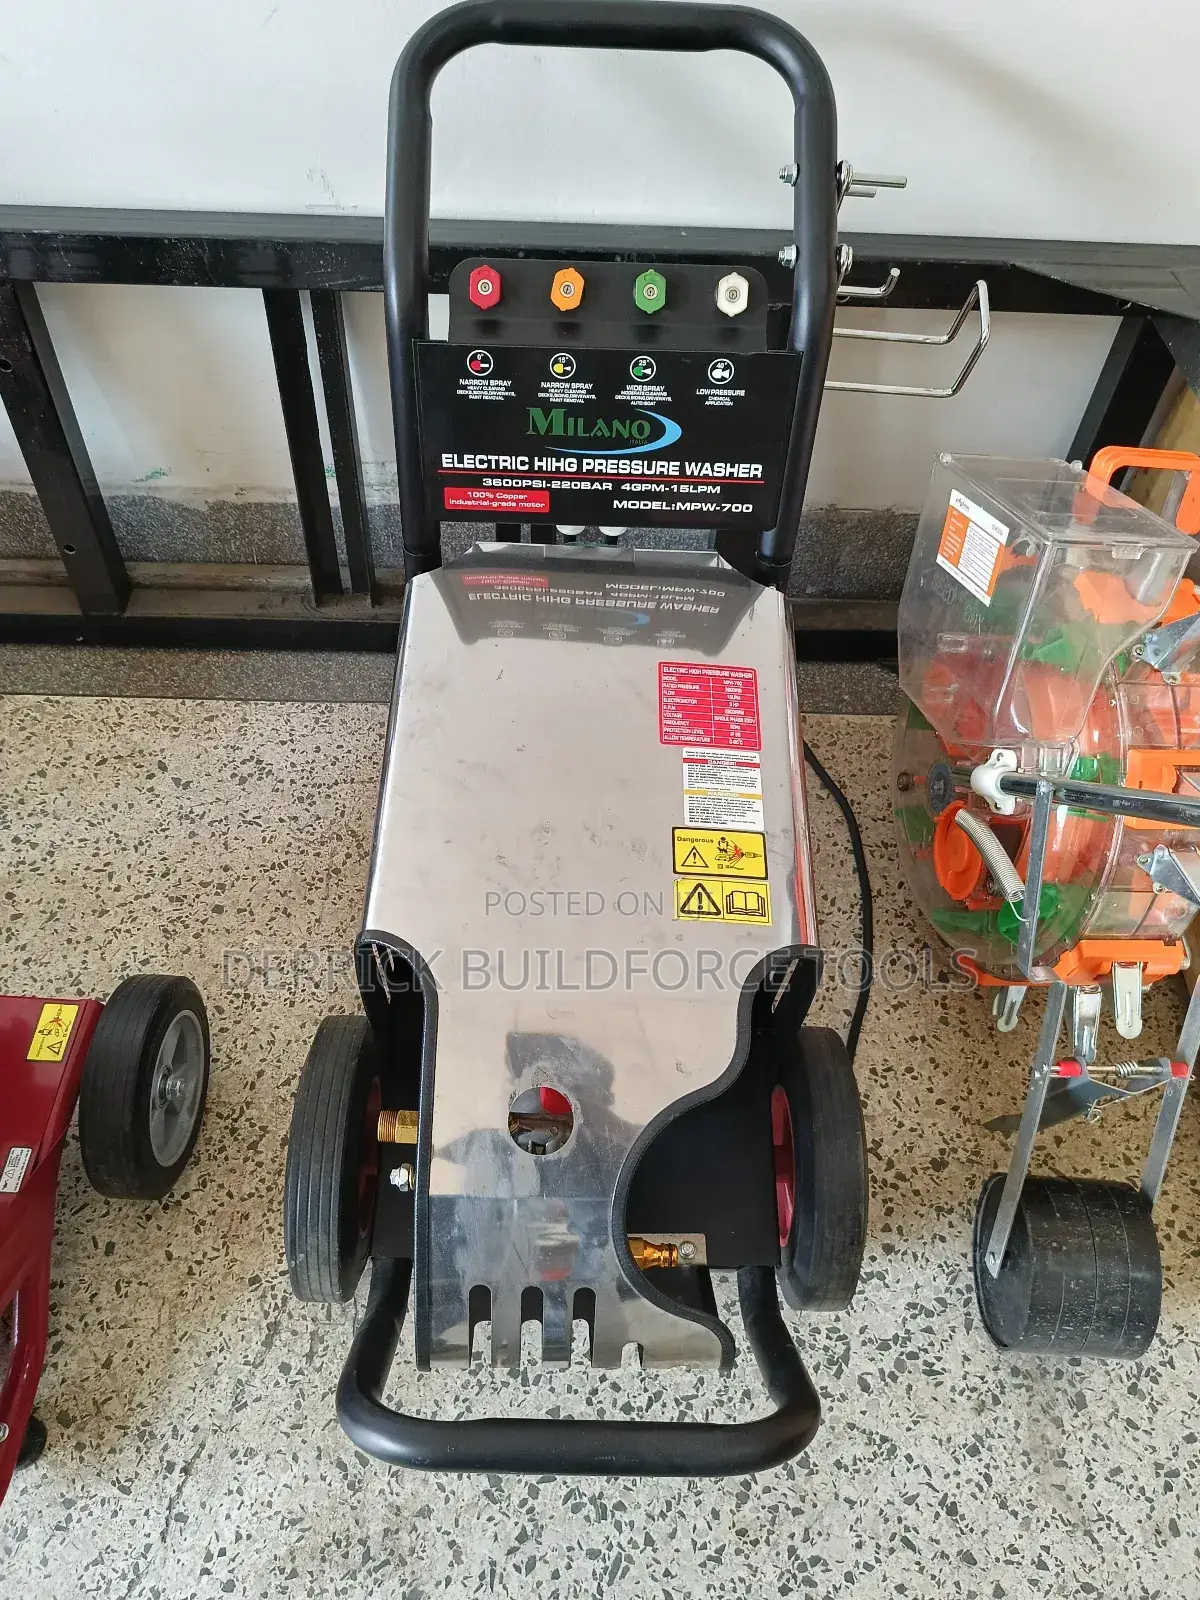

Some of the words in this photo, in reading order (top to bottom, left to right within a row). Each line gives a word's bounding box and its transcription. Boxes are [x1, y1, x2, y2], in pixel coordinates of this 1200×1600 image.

[540, 381, 570, 389] NARROW
[441, 453, 530, 471] ELECTRIC
[534, 456, 578, 473] HIHG
[582, 458, 681, 477] PRESSURE
[684, 461, 763, 479] WASHER
[482, 477, 613, 491] 3600PSI-220BAR
[620, 482, 721, 494] 4GPM-15LPM
[467, 491, 494, 499] 100%
[495, 492, 528, 501] Copper
[518, 501, 546, 509] motor
[612, 499, 753, 513] MODEL:MPW-700
[676, 835, 715, 844] Dangerous
